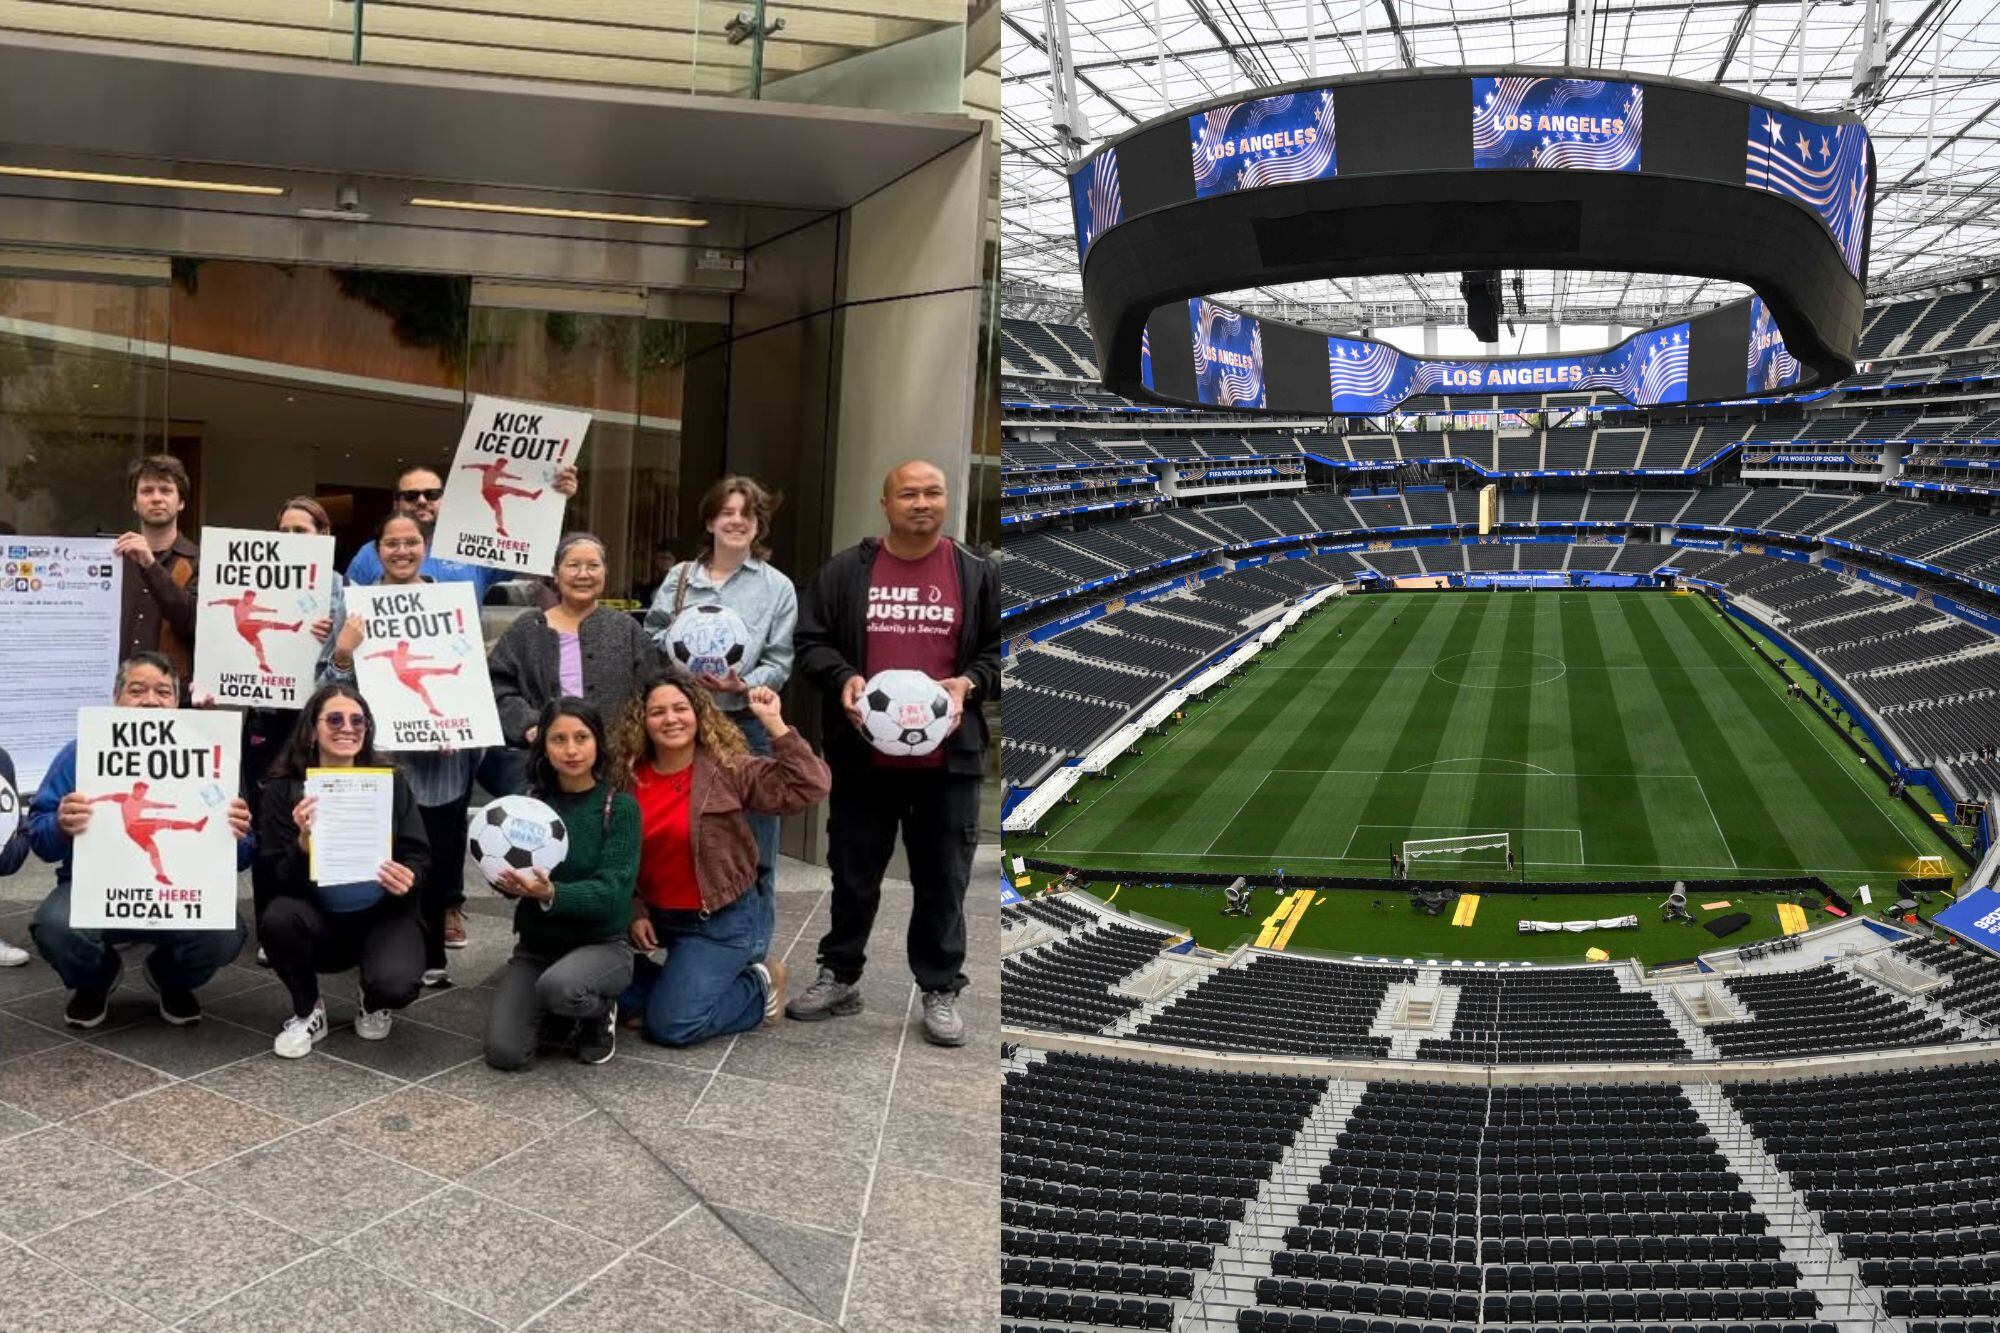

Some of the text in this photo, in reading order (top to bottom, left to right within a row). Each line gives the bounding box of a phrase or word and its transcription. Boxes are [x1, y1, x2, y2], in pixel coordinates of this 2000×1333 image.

[1494, 114, 1624, 135] LOS ANGELES
[1206, 127, 1317, 161] LOS ANGELES
[1202, 343, 1253, 370] LOS ANGELES
[1442, 366, 1581, 386] LOS ANGELES
[492, 412, 543, 435] KICK
[475, 432, 569, 464] ICE OUT!
[1042, 484, 1071, 492] ANGELES
[228, 540, 281, 562] KICK
[459, 532, 530, 552] UNITE HERE!
[456, 543, 528, 565] LOCAL 11
[216, 564, 317, 590] ICE OUT!
[868, 586, 920, 601] CLUE
[372, 592, 425, 617] KICK
[866, 604, 955, 623] JUSTICE
[365, 608, 464, 640] ICE OUT!
[220, 673, 296, 688] UNITE HERE!
[219, 683, 295, 701] LOCAL 11
[112, 720, 177, 748] KICK
[393, 717, 470, 732] UNITE HERE!
[395, 728, 473, 743] LOCAL 11
[97, 745, 221, 780] ICE OUT!
[106, 888, 202, 901] UNITE HERE!
[105, 903, 202, 919] LOCAL 11
